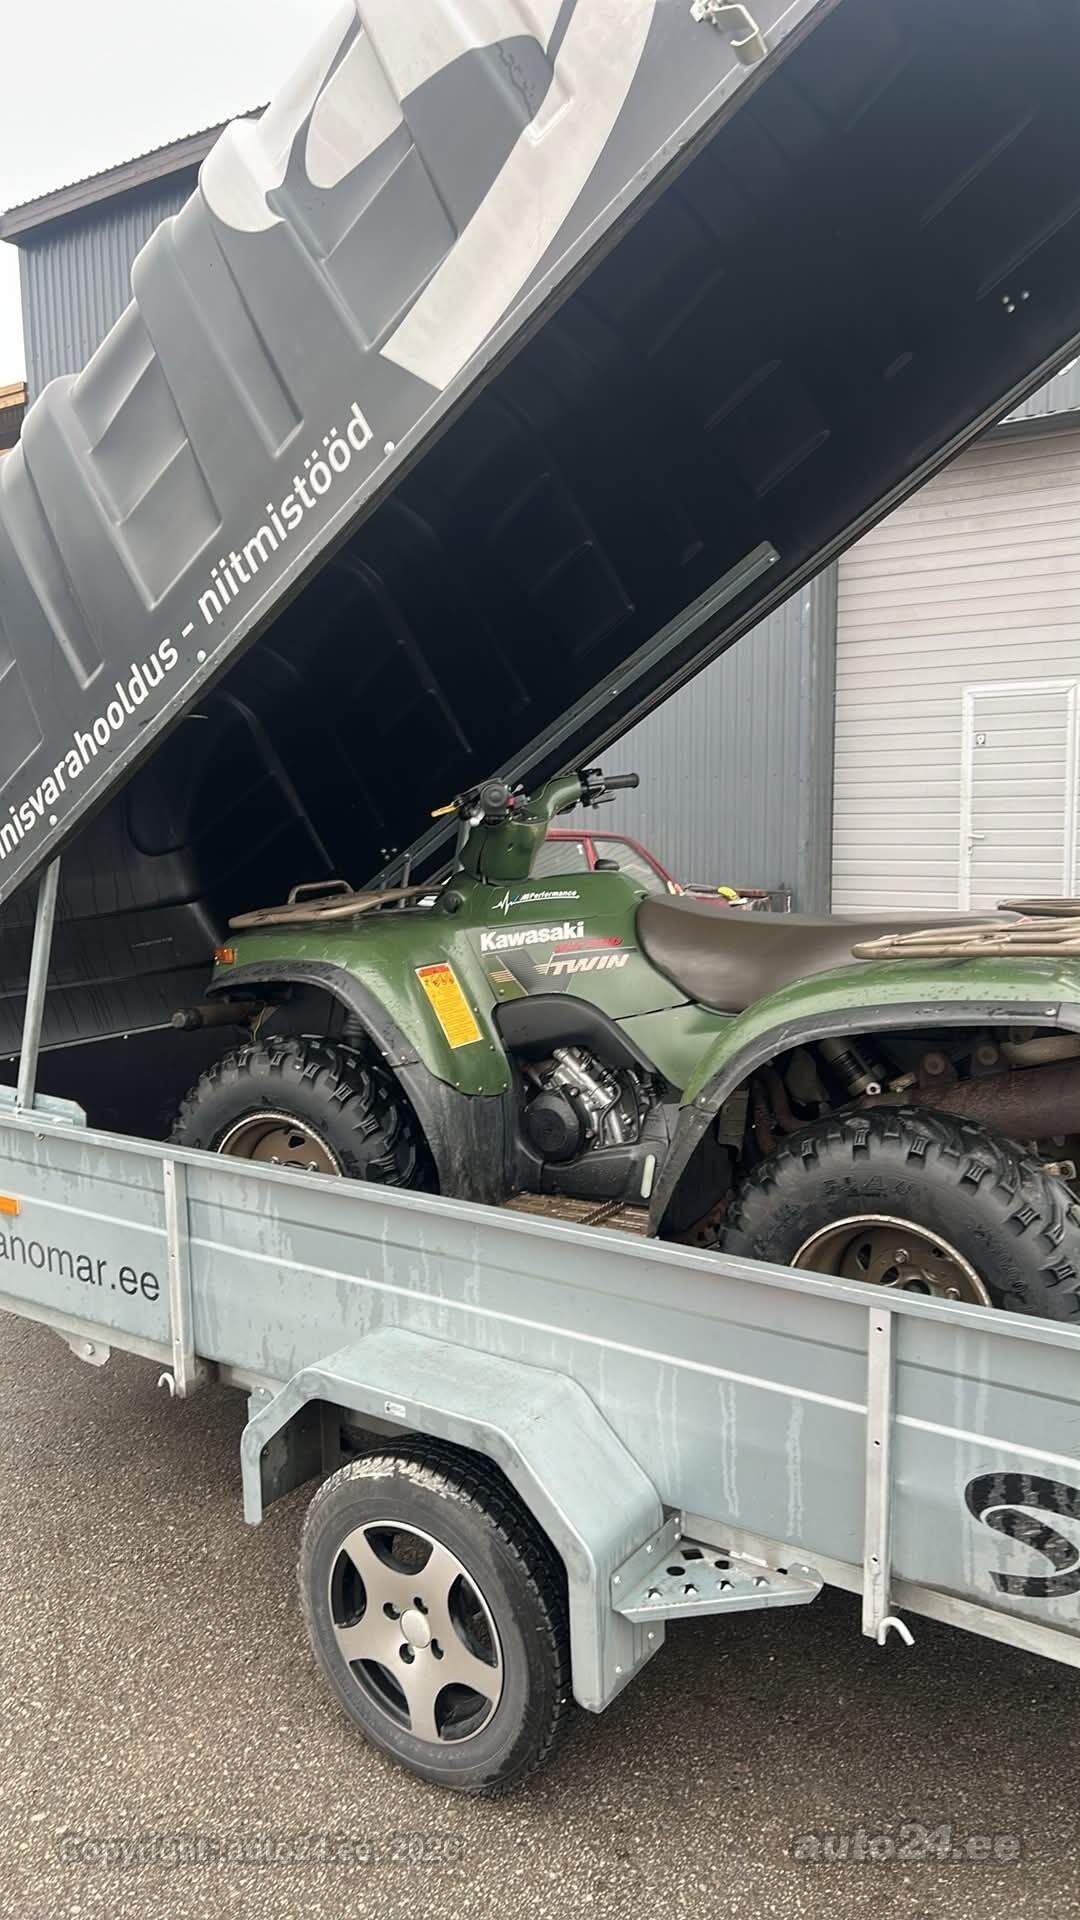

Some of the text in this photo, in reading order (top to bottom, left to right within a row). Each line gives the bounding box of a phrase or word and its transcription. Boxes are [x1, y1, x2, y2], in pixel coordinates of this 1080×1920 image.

[198, 402, 374, 624] niitmistööd
[480, 921, 584, 951] Kawasaki
[550, 954, 629, 975] TWIN
